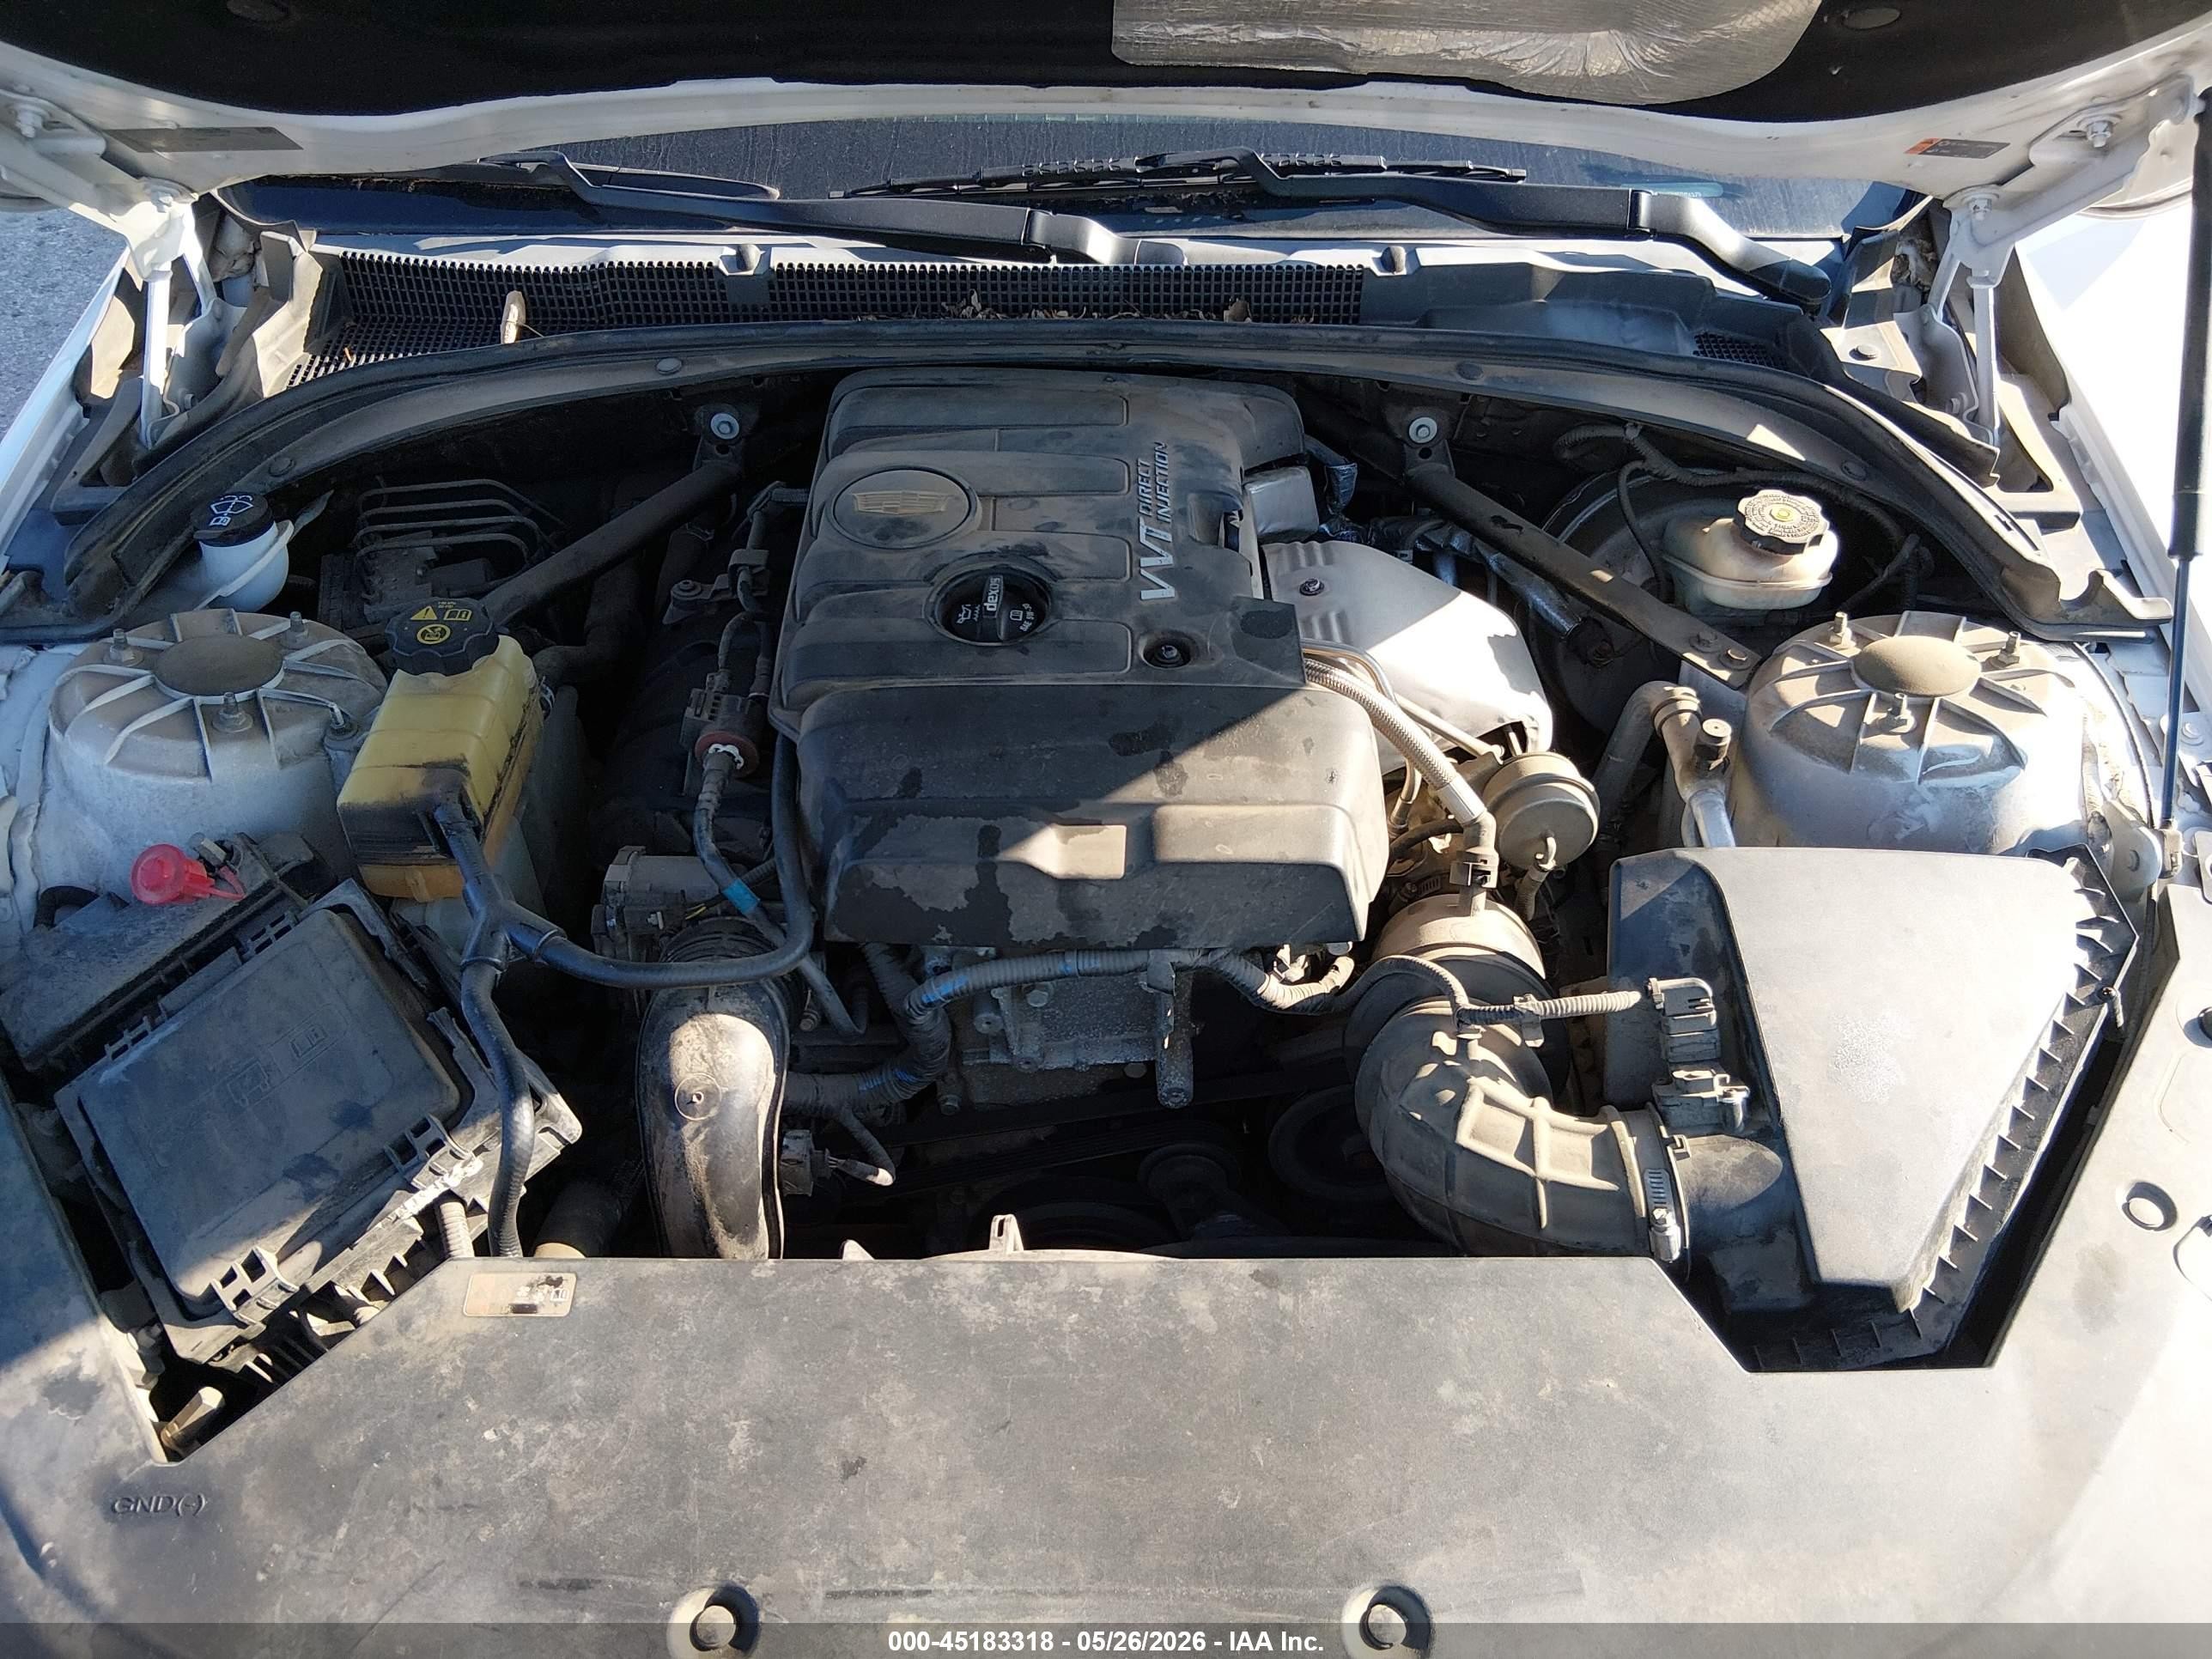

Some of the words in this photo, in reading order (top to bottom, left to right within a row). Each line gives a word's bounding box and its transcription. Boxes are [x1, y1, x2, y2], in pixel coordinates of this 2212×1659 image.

[1137, 458, 1152, 517] DIRECT
[1154, 441, 1172, 524] INJECTION
[983, 577, 1000, 611] dexos
[111, 1493, 208, 1516] GND(-)
